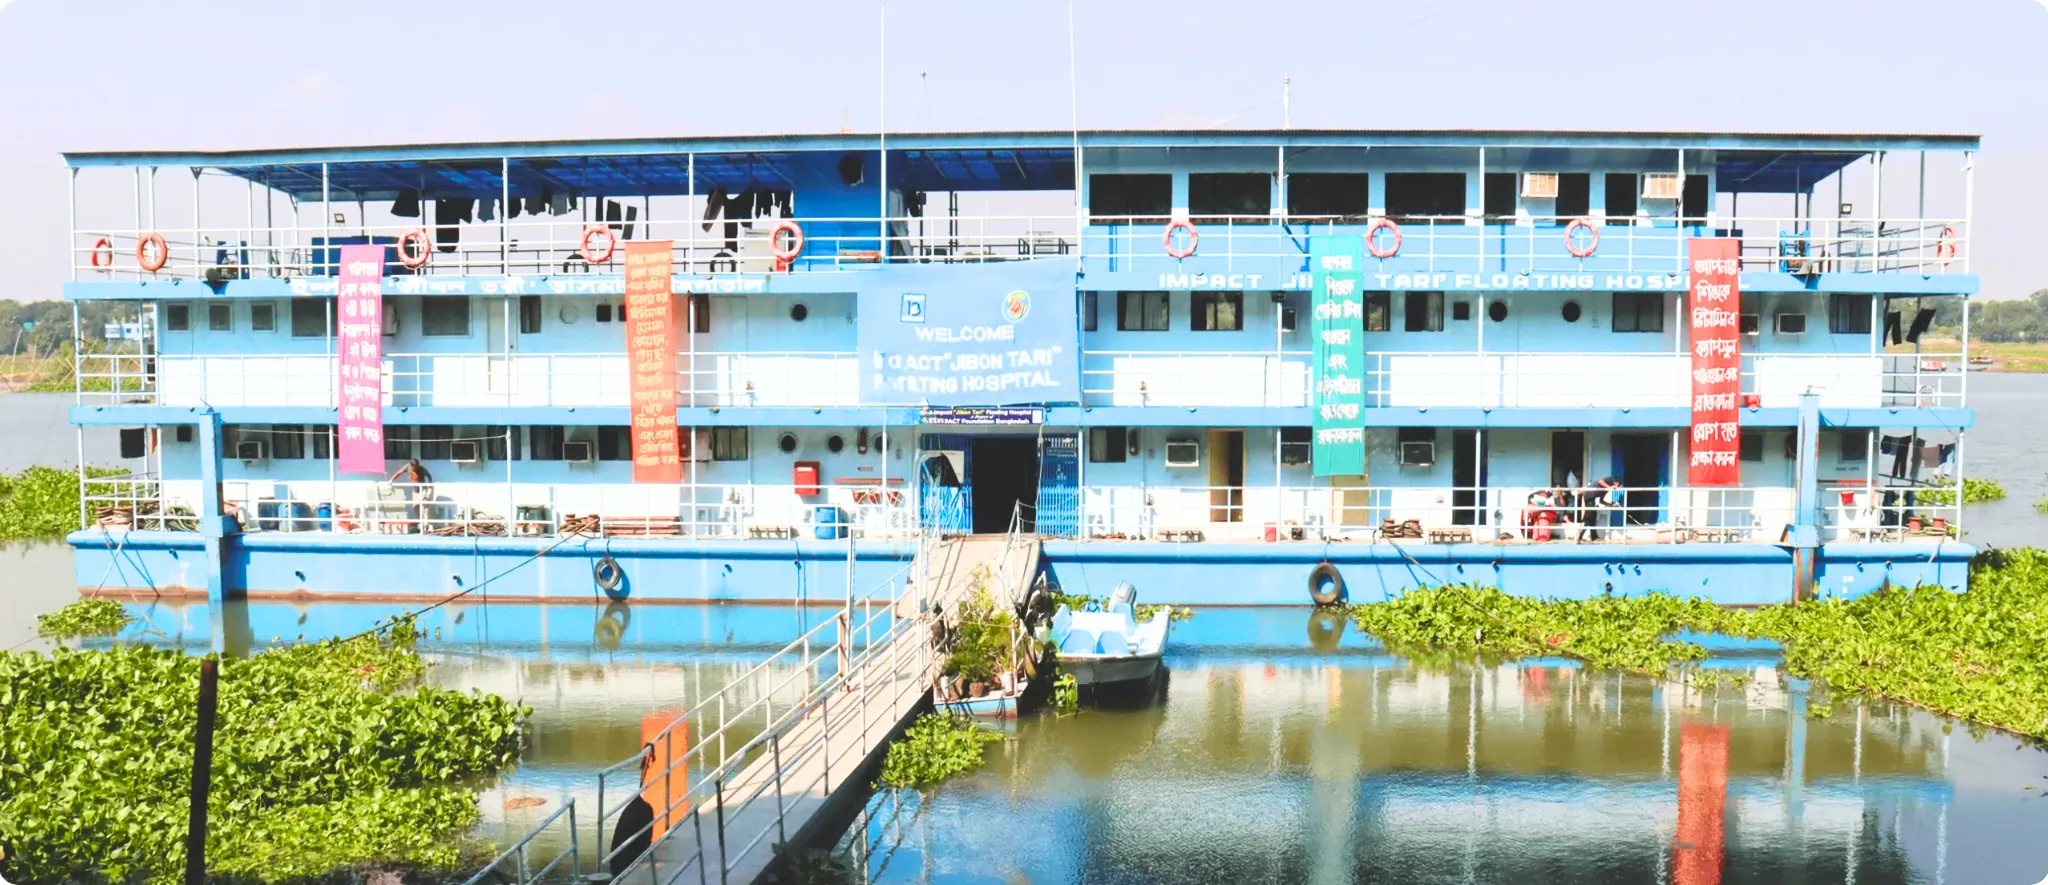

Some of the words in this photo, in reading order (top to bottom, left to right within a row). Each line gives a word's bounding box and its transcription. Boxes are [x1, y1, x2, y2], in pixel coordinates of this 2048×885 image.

[1694, 259, 1738, 276] আপনার
[1159, 274, 1262, 288] IMPACT
[1456, 274, 1594, 288] FLOATING
[1606, 275, 1750, 290] HOSPIL
[1695, 280, 1732, 303] শিশুকে
[915, 324, 1015, 342] WELCOME
[1695, 338, 1738, 359] ক্যাপসুল
[962, 370, 1060, 392] HOSPITAL
[1694, 392, 1736, 412] রাতকানা
[1694, 421, 1720, 442] রোগ
[1720, 422, 1738, 442] হতে
[1690, 450, 1714, 468] রক্ষা
[1714, 450, 1738, 467] করুন
